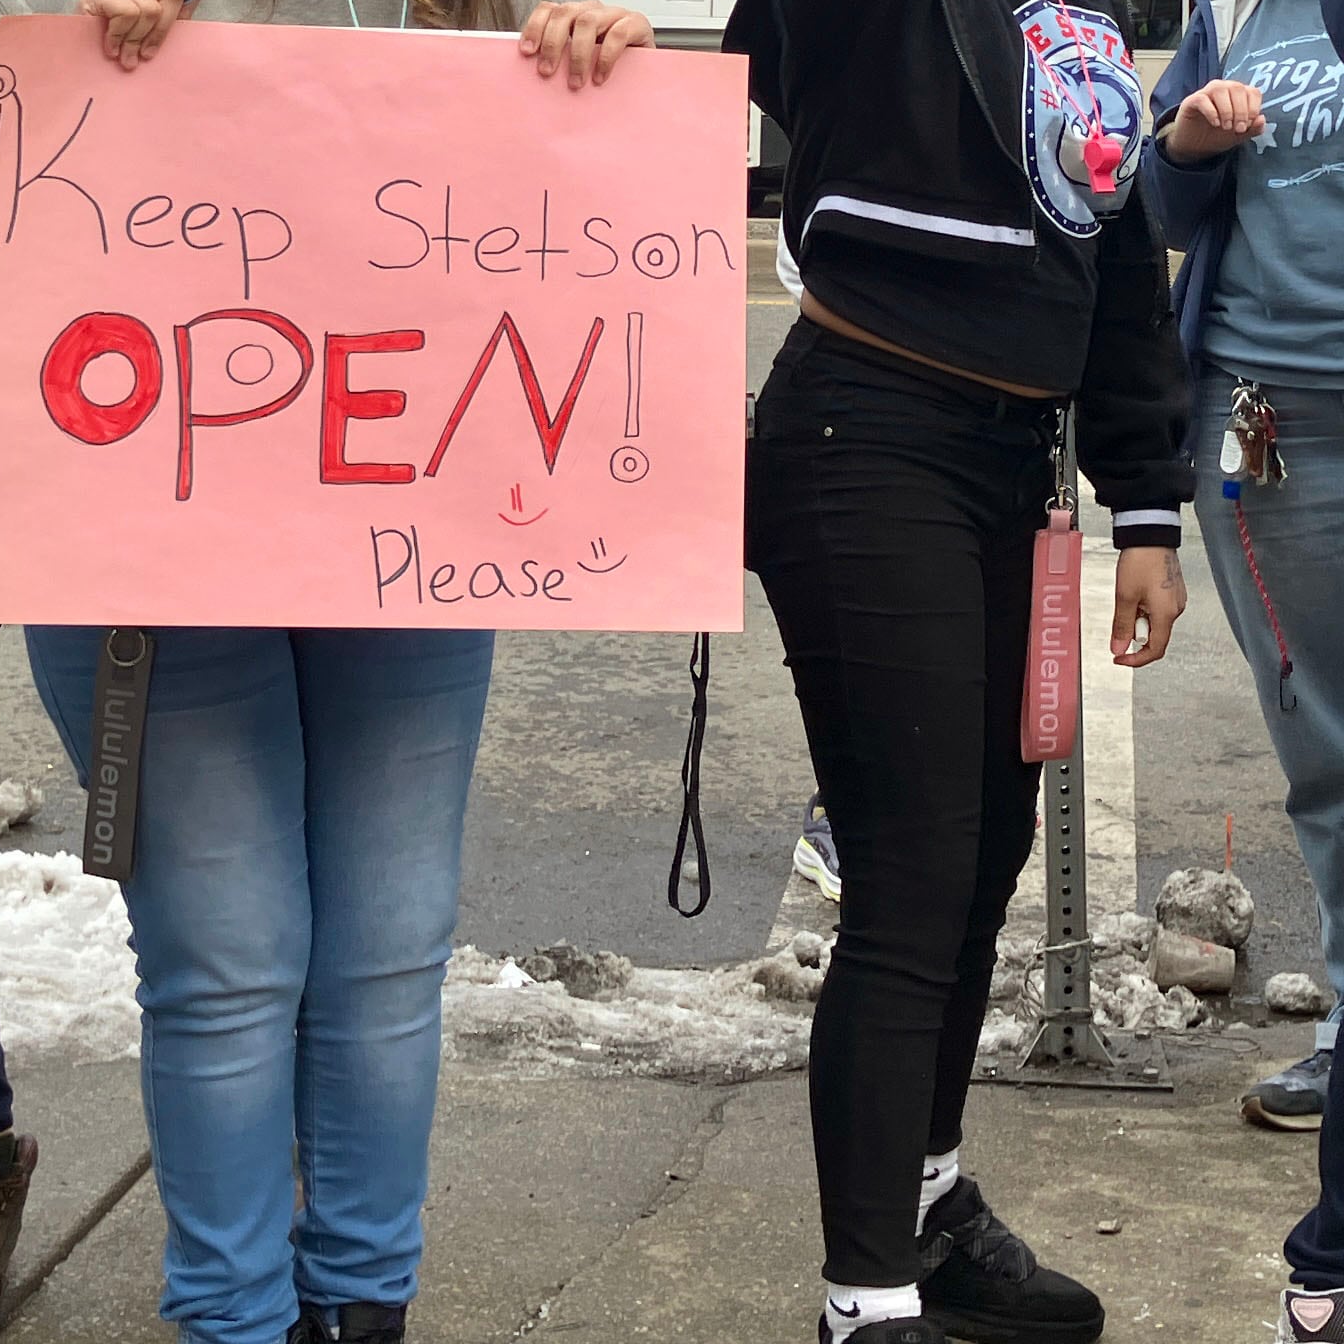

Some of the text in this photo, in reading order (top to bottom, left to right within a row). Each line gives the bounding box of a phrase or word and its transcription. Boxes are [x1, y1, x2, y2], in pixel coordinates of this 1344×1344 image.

[368, 179, 737, 280] Stetson
[370, 524, 572, 609] Please
[1038, 584, 1071, 753] lululemon
[92, 687, 136, 866] lululemon
